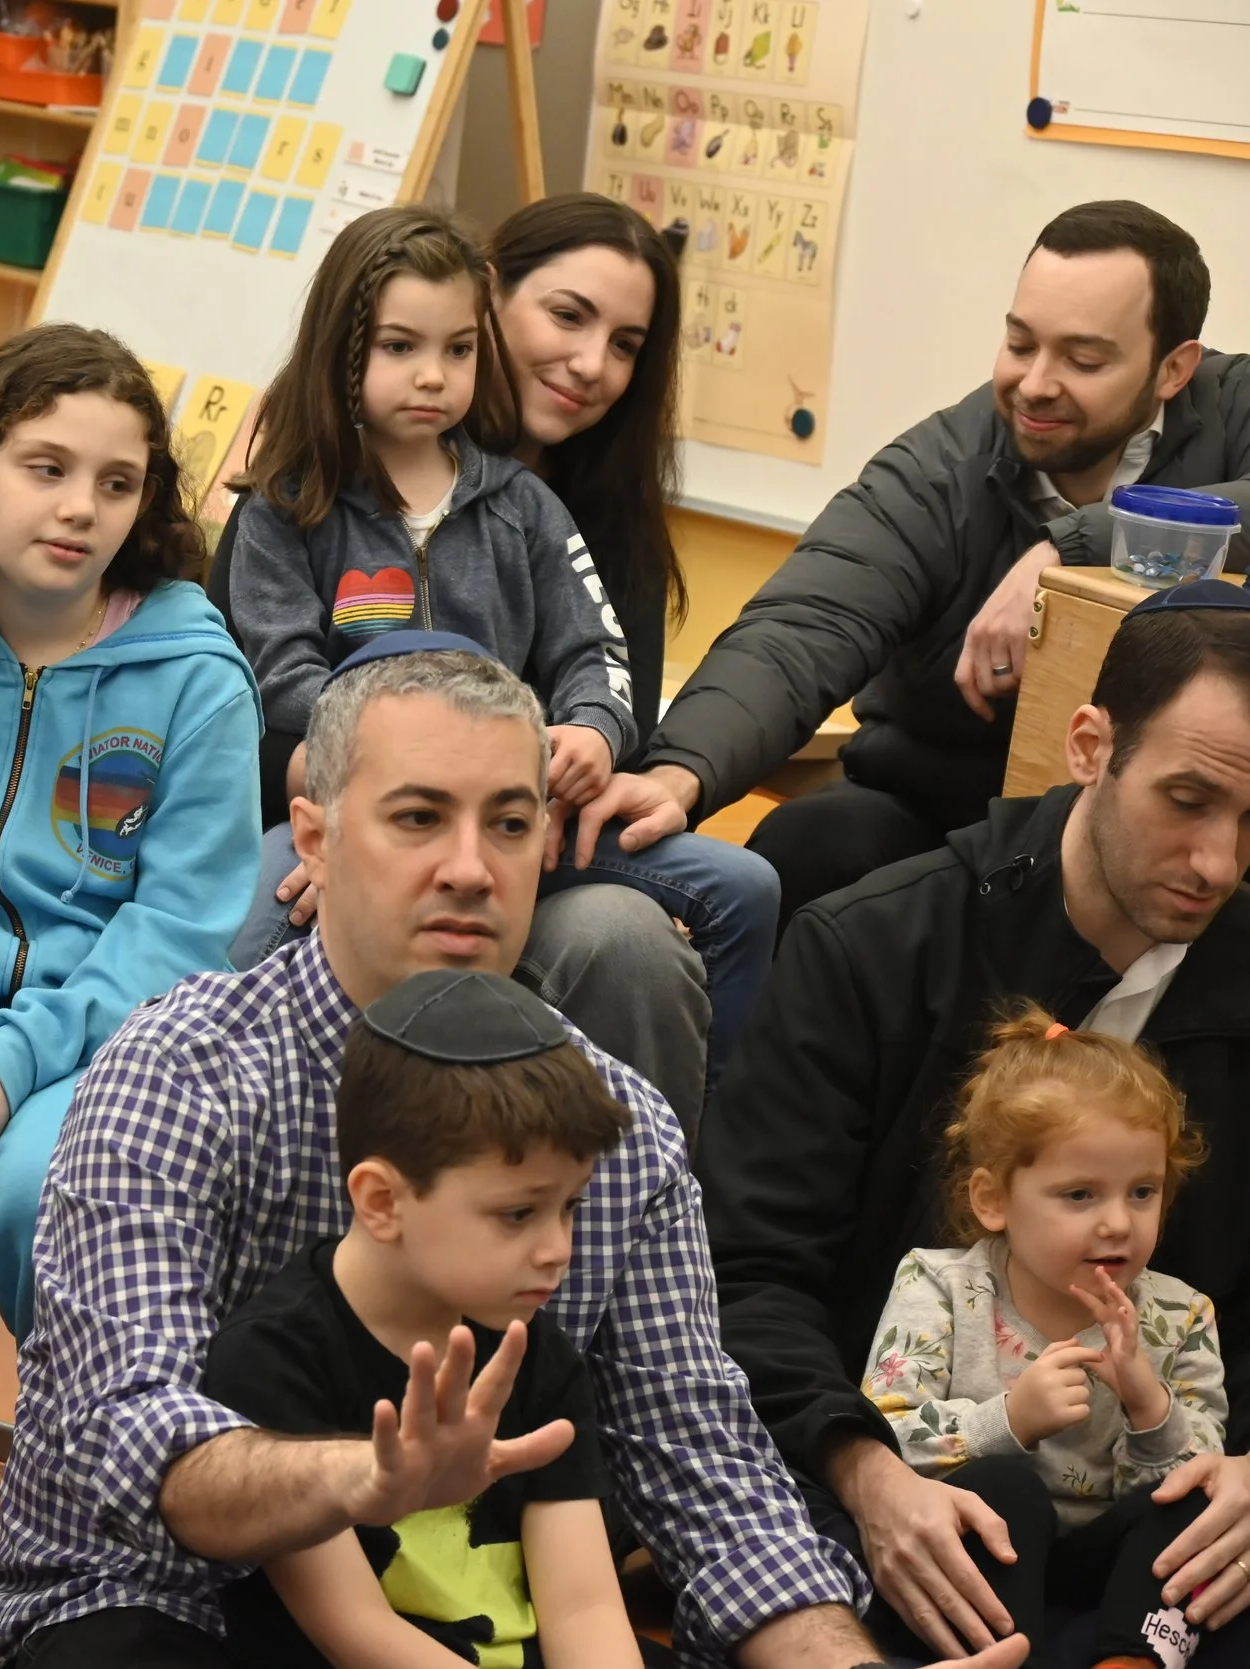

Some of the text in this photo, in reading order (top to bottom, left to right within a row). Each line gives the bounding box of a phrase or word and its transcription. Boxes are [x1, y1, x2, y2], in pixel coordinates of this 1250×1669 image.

[199, 385, 227, 422] Rr
[78, 736, 130, 768] VIATOR
[76, 843, 126, 875] VNICE,
